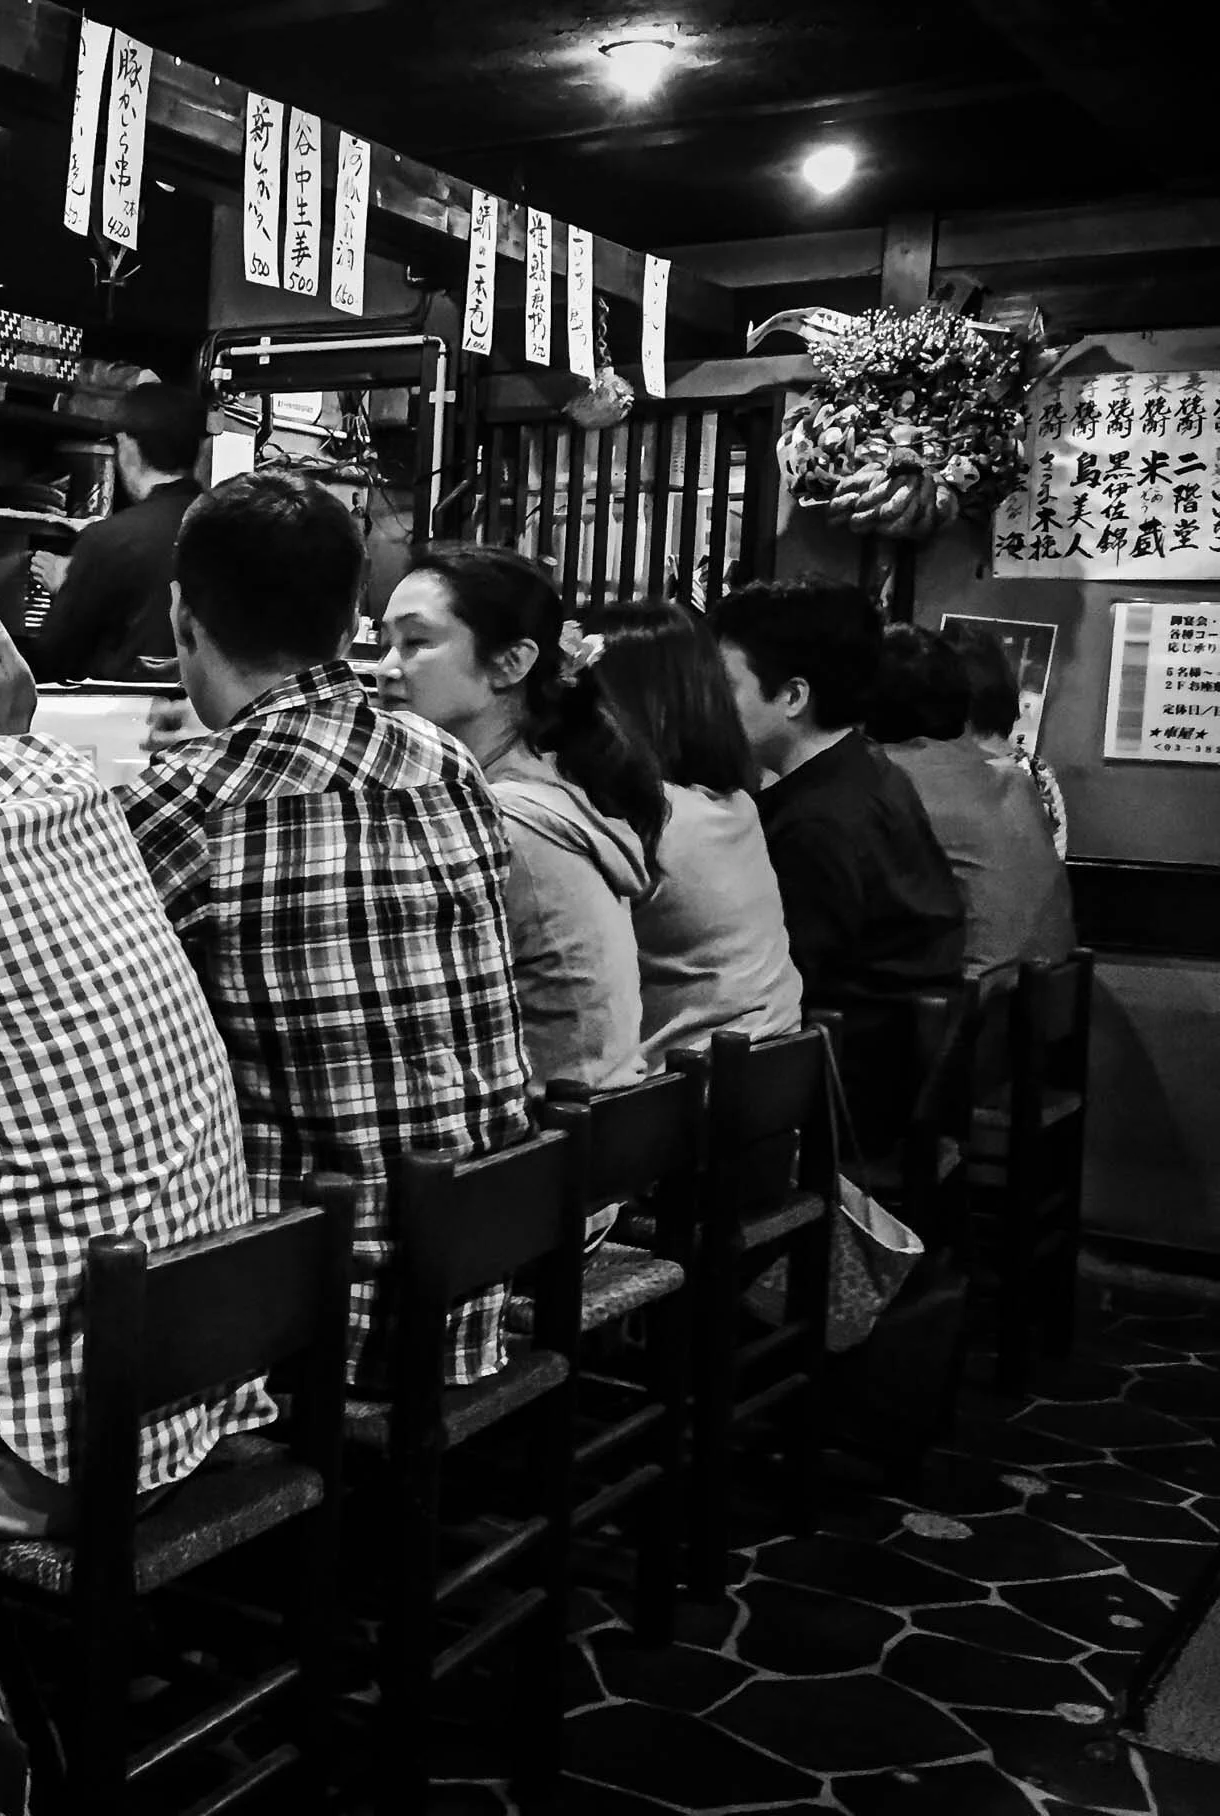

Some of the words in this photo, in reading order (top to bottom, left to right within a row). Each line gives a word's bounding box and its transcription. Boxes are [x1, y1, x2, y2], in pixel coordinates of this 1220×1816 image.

[289, 272, 314, 292] 500
[1096, 450, 1136, 567] 黒伊佐錦
[1169, 452, 1207, 552] 二階堂
